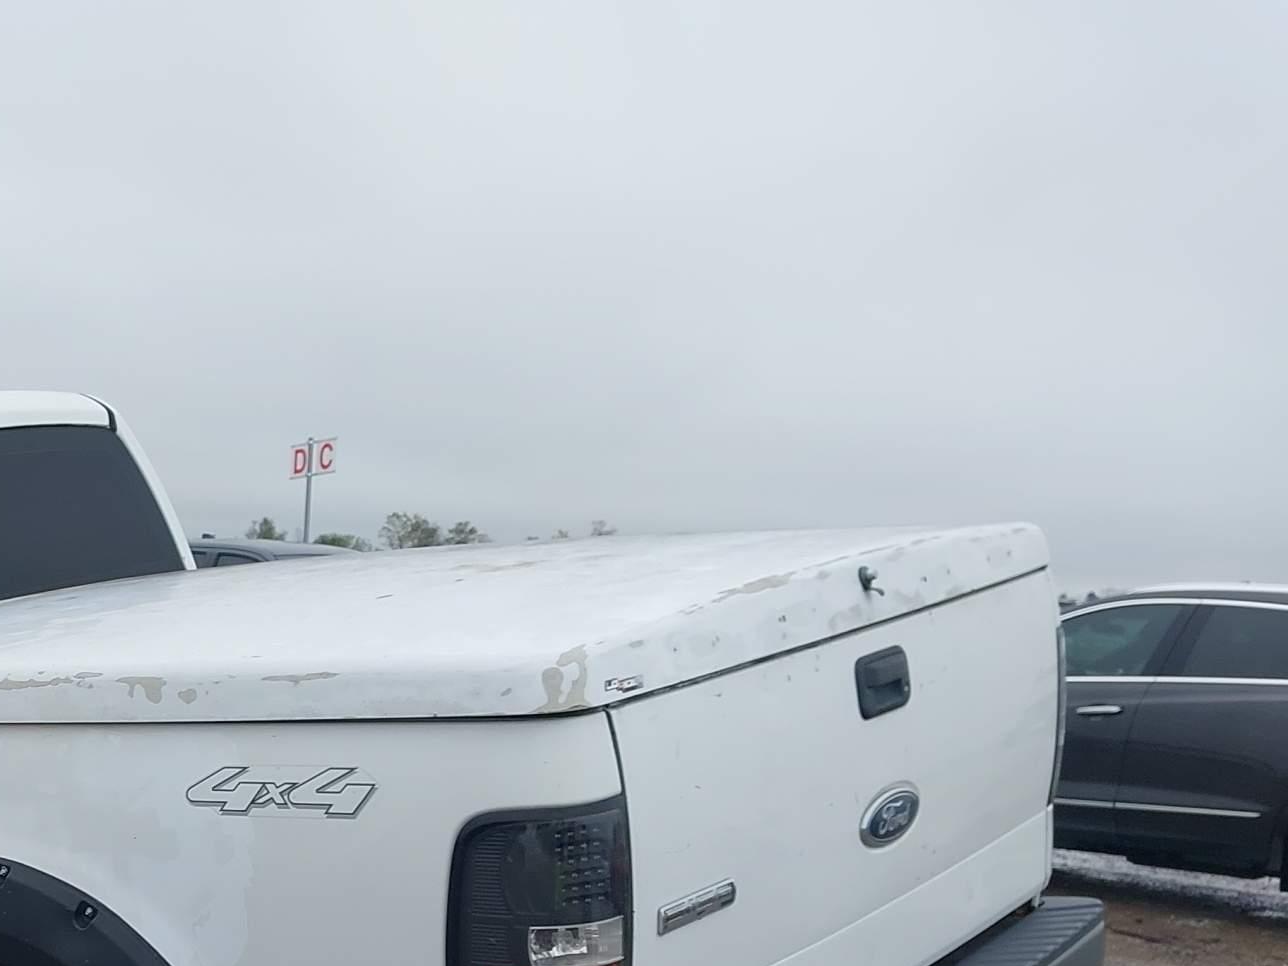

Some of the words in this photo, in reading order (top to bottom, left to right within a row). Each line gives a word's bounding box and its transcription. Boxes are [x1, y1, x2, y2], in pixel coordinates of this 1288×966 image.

[294, 449, 307, 474] D
[320, 443, 333, 470] C
[185, 766, 378, 819] 4x4
